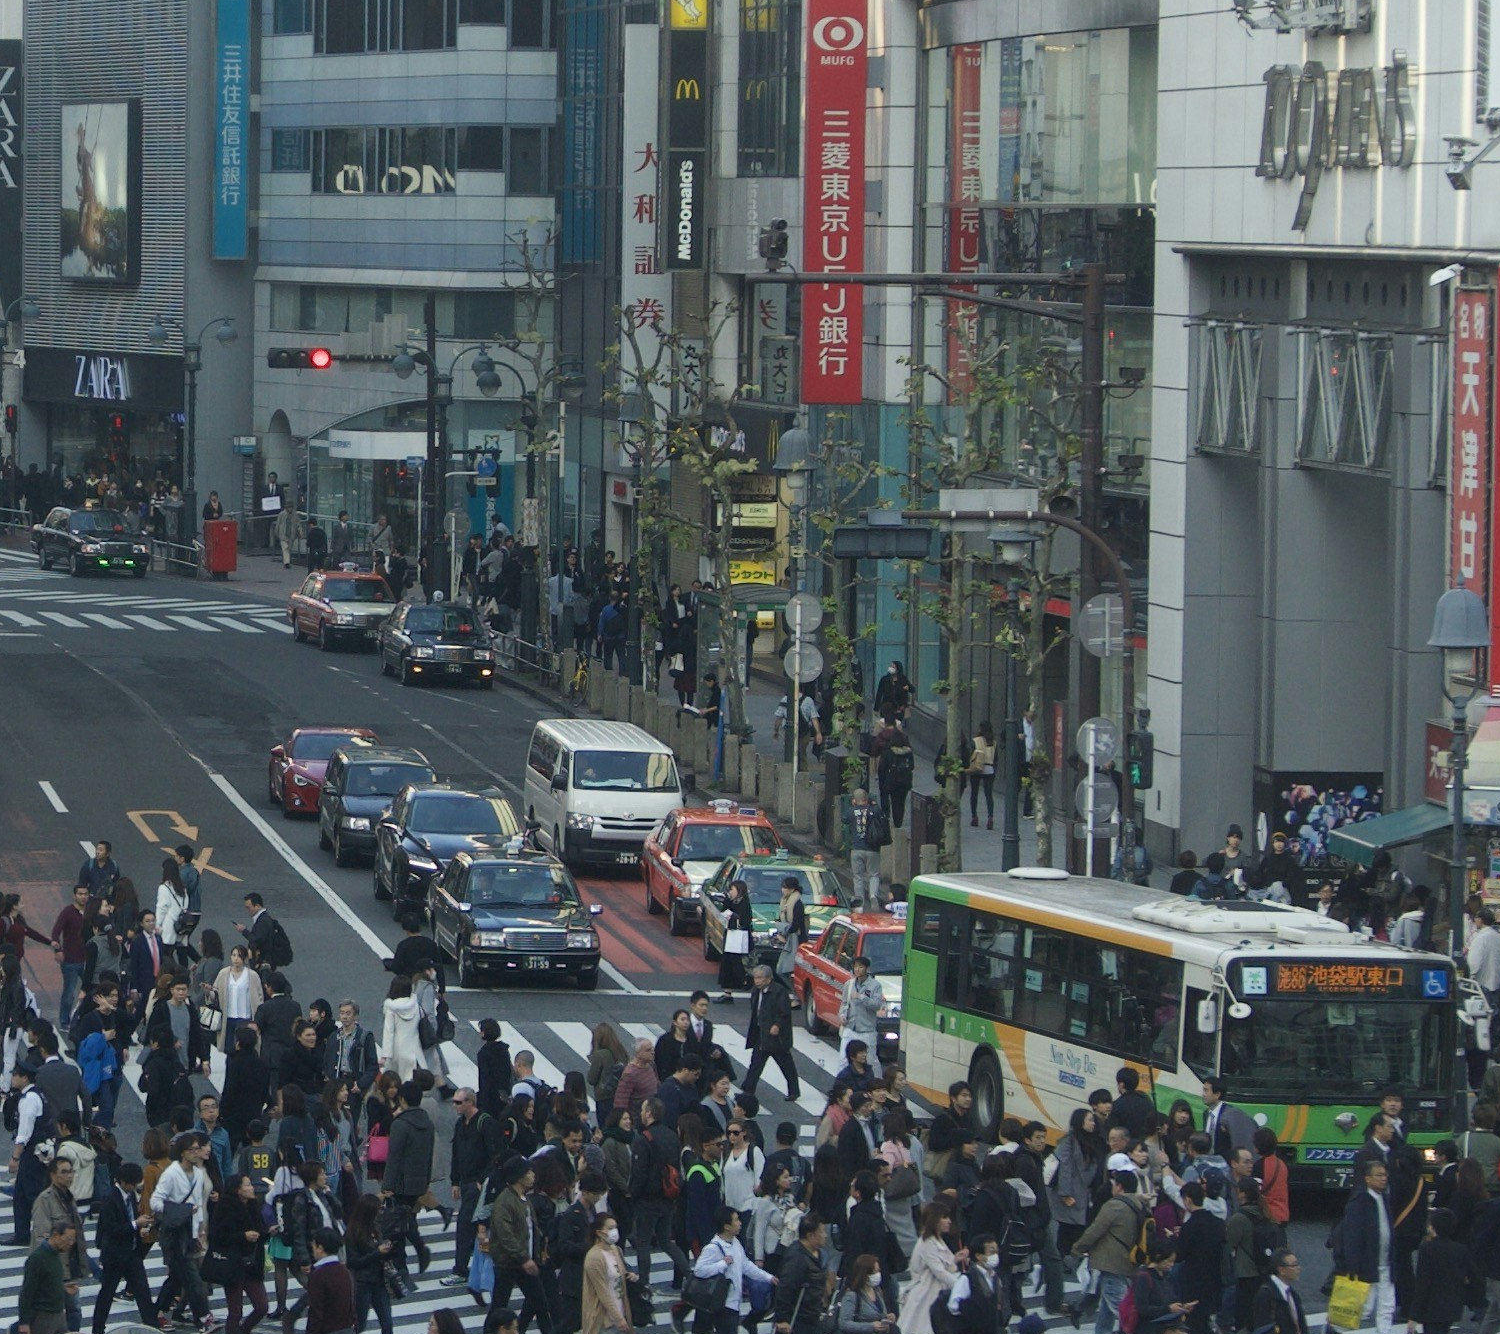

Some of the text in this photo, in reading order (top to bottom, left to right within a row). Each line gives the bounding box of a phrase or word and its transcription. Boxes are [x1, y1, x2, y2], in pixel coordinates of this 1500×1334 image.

[820, 55, 856, 67] MUFG
[221, 44, 242, 206] 三井住友信託銀行
[679, 159, 695, 261] McDonald's
[633, 142, 666, 330] 大和証券
[818, 110, 853, 377] 三菱東京UFJ銀行
[75, 355, 128, 401] ZARA
[730, 570, 774, 582] ンタクト
[1309, 966, 1404, 987] 池袋駅東口
[252, 1153, 270, 1170] 58
[1306, 1149, 1358, 1161] ノンステッ
